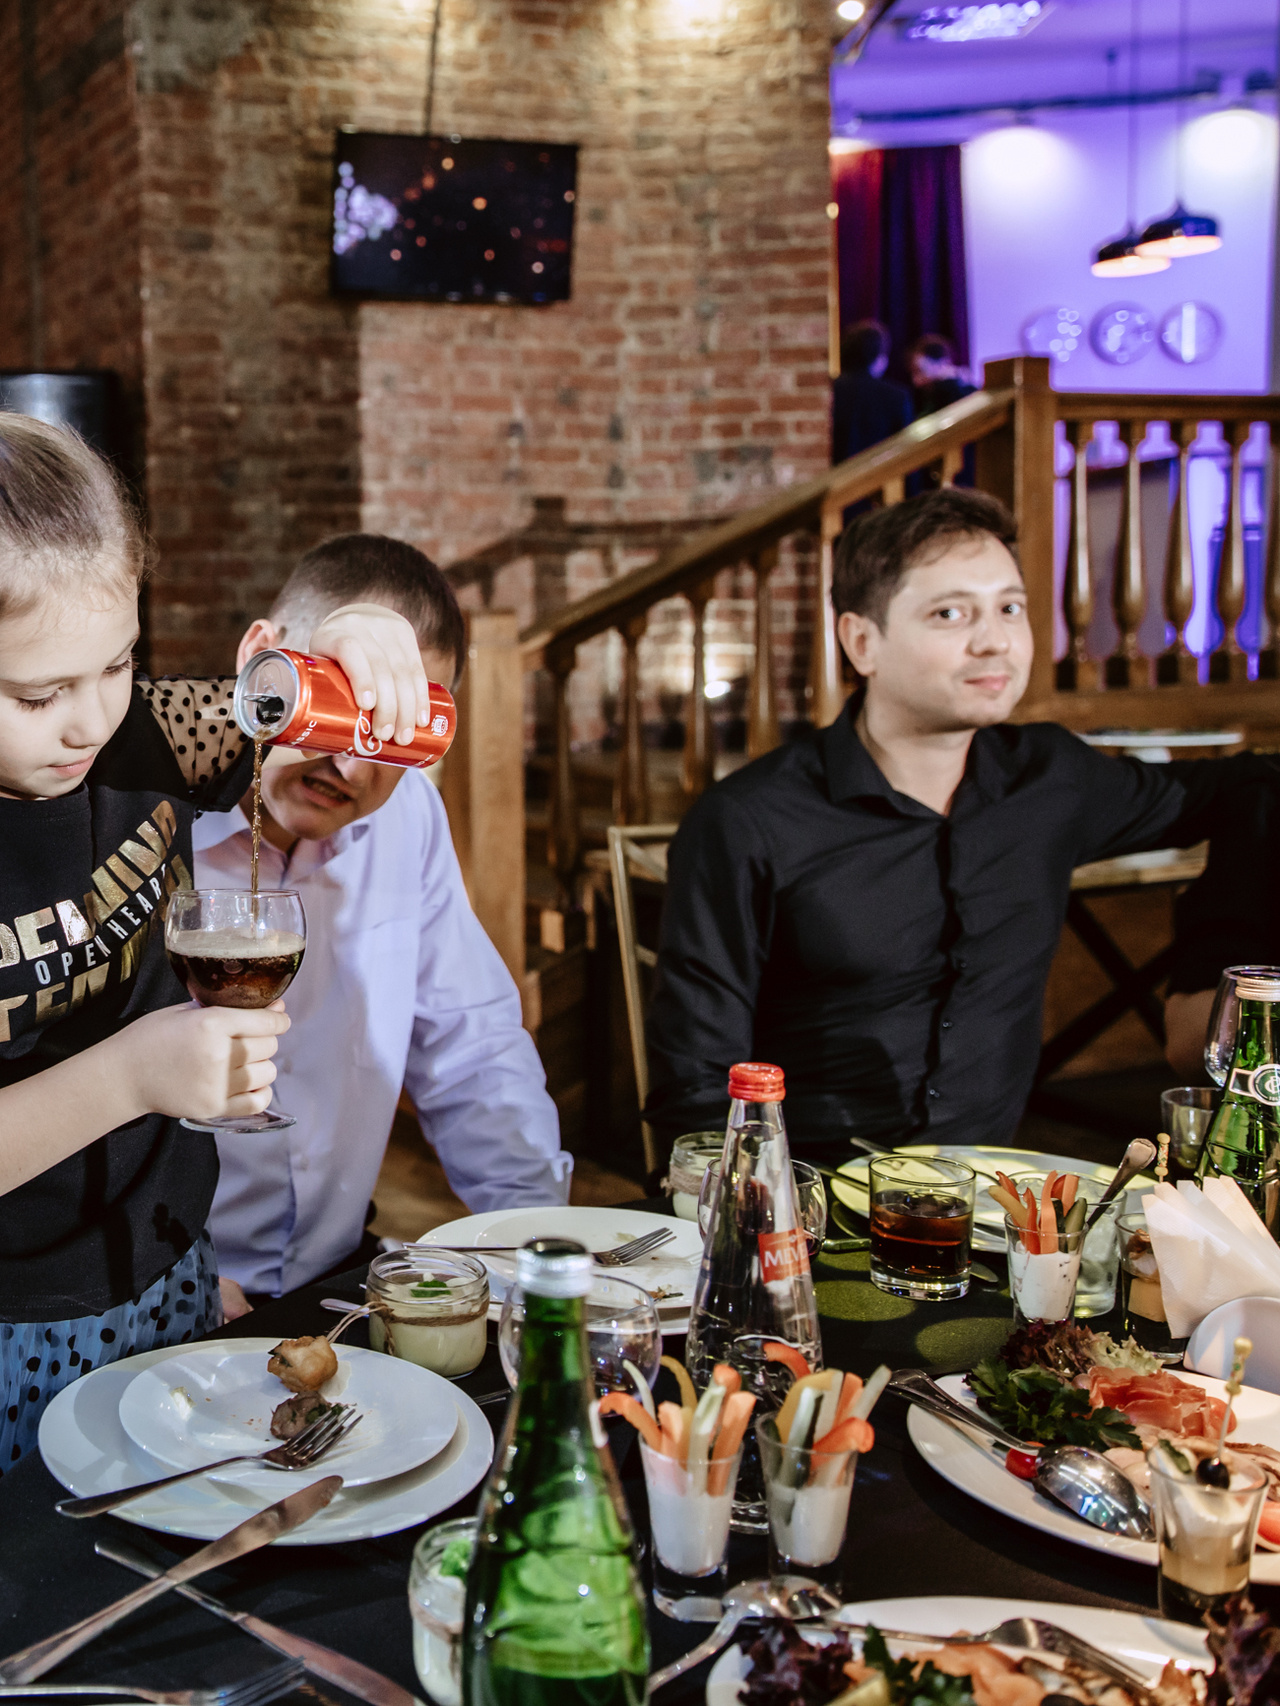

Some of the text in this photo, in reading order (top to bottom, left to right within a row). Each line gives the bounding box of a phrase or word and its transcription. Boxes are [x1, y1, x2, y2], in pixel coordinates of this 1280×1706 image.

[291, 720, 318, 745] ASSIC
[34, 934, 112, 985] OPEN
[764, 1241, 808, 1268] MEVE
